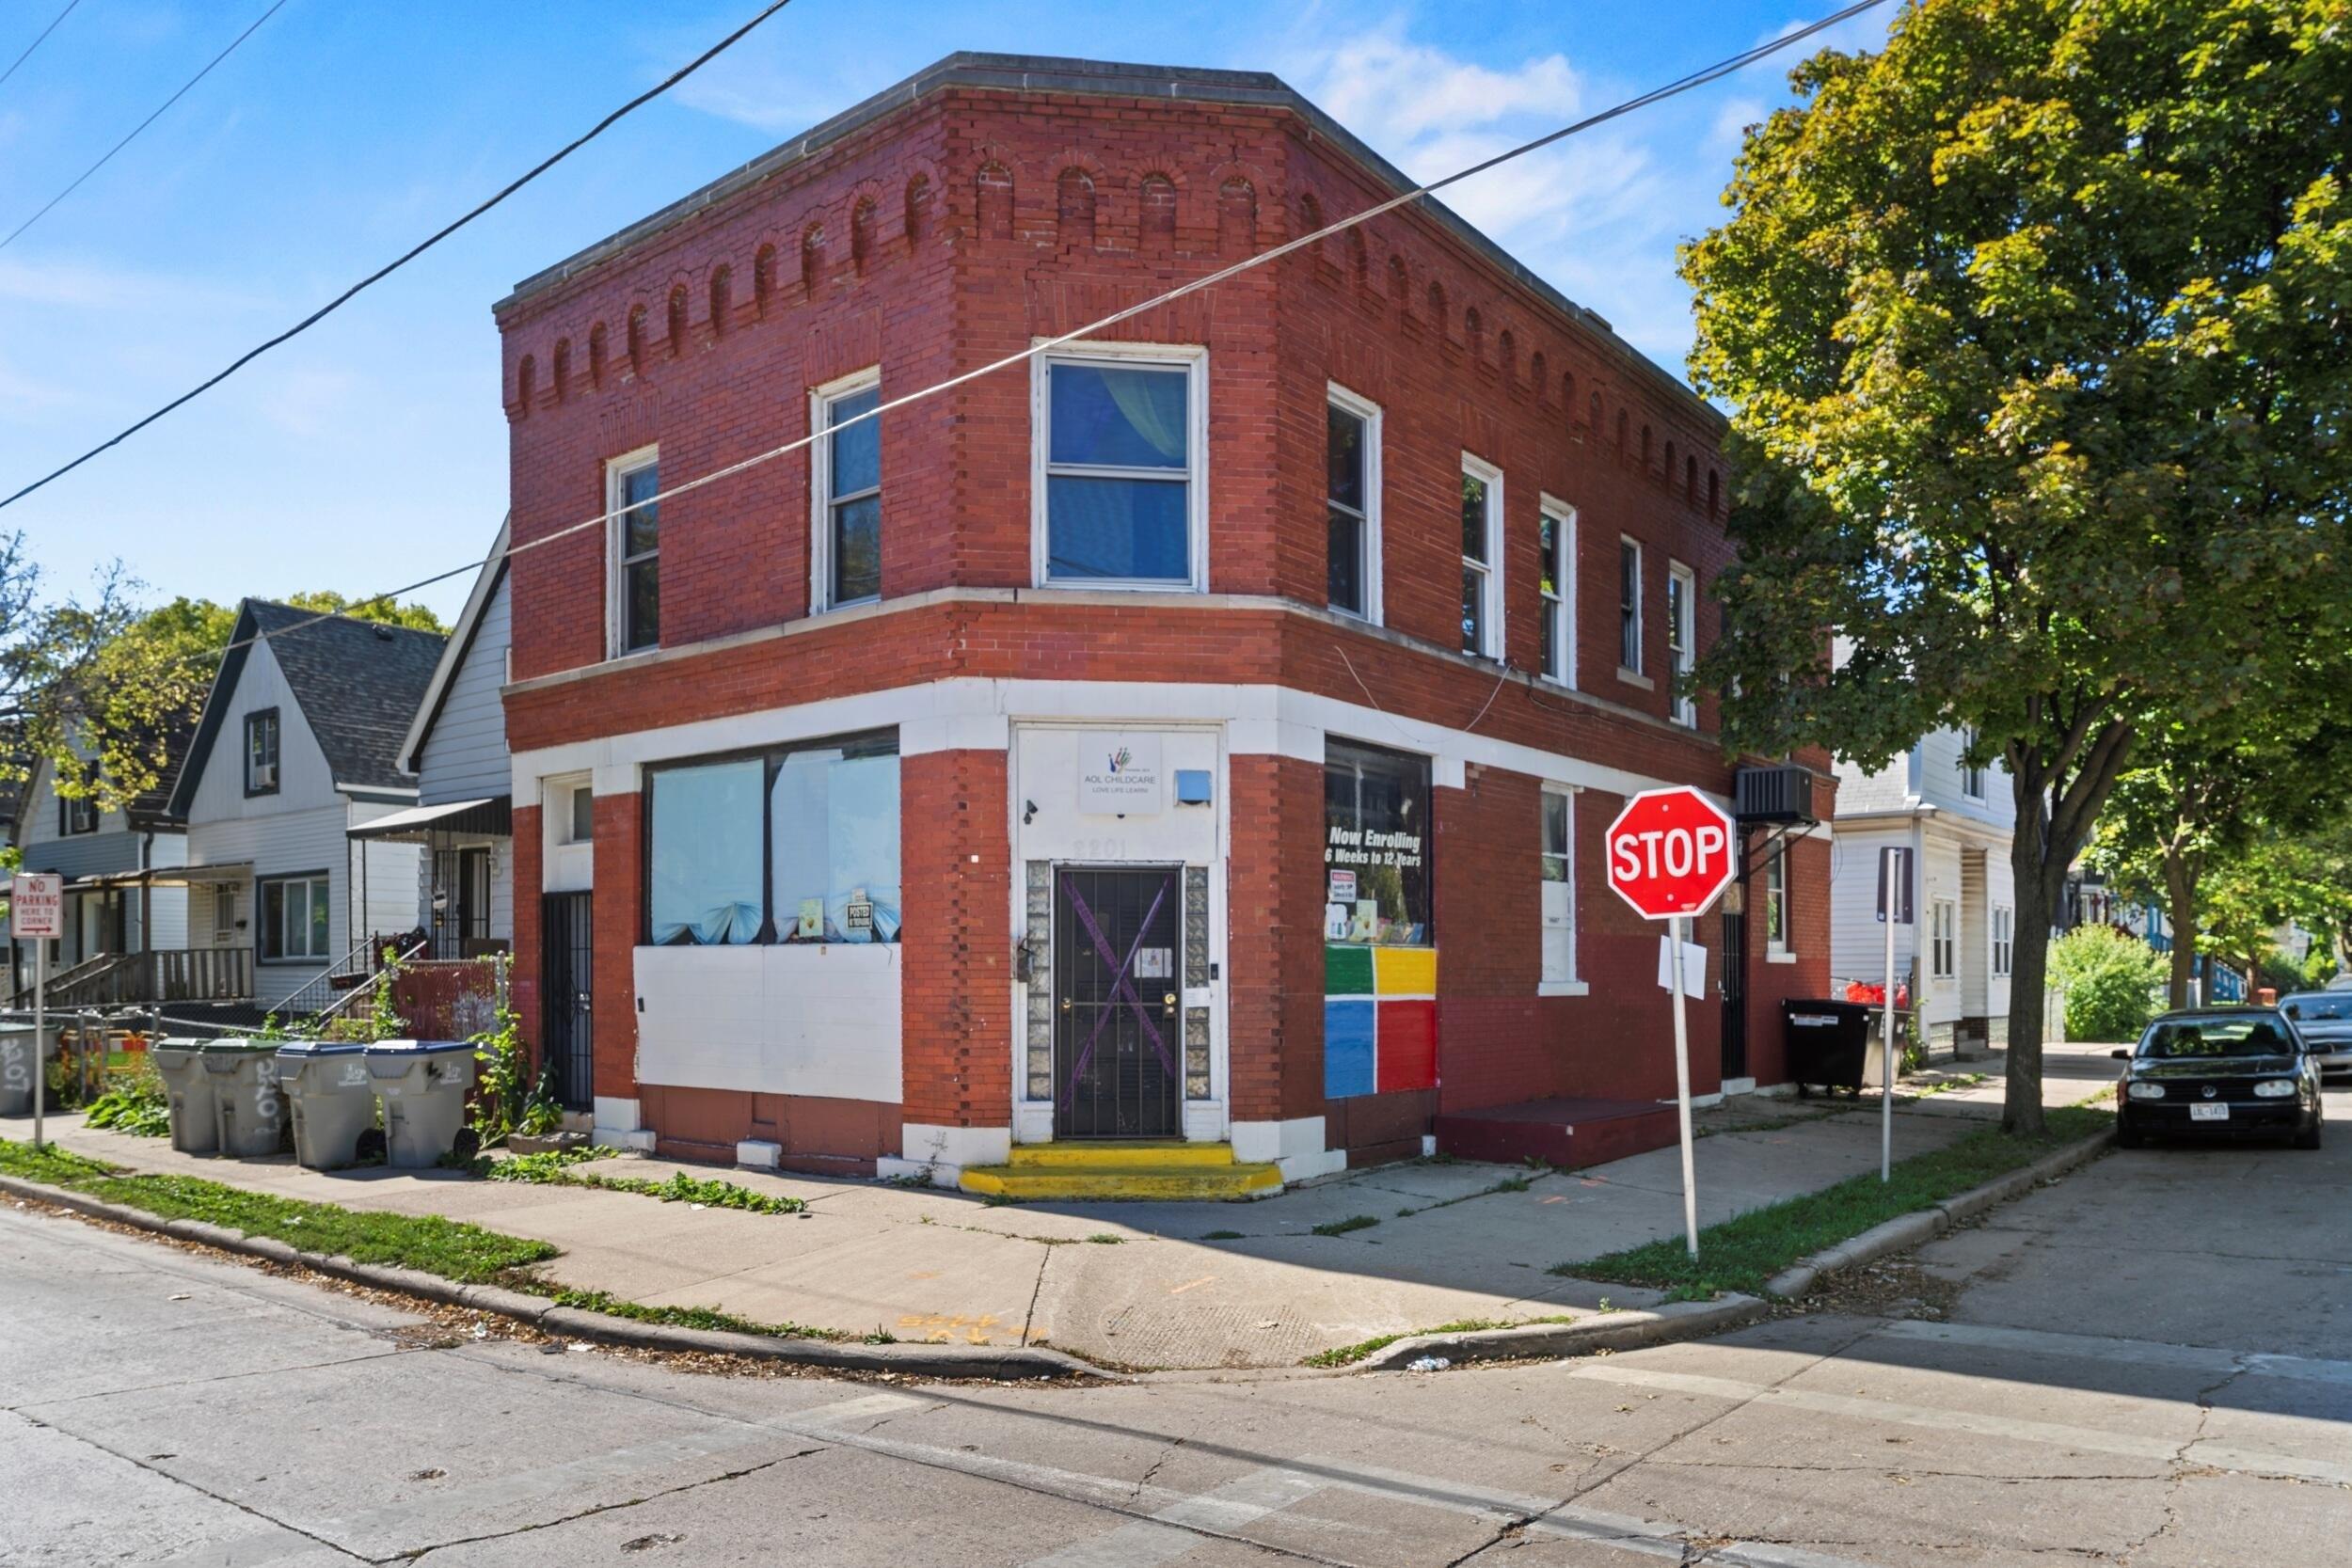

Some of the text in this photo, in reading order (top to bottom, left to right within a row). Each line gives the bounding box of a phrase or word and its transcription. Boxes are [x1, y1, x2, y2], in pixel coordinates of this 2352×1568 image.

[1084, 774, 1156, 784] AOL CHILDCARE
[1329, 826, 1421, 853] Now Enrolling
[1324, 847, 1422, 867] 6 Weeks to 12 Years
[1614, 825, 1724, 882] STOP
[29, 880, 45, 893] NO
[16, 895, 59, 907] PARKING
[22, 917, 54, 926] CORNER
